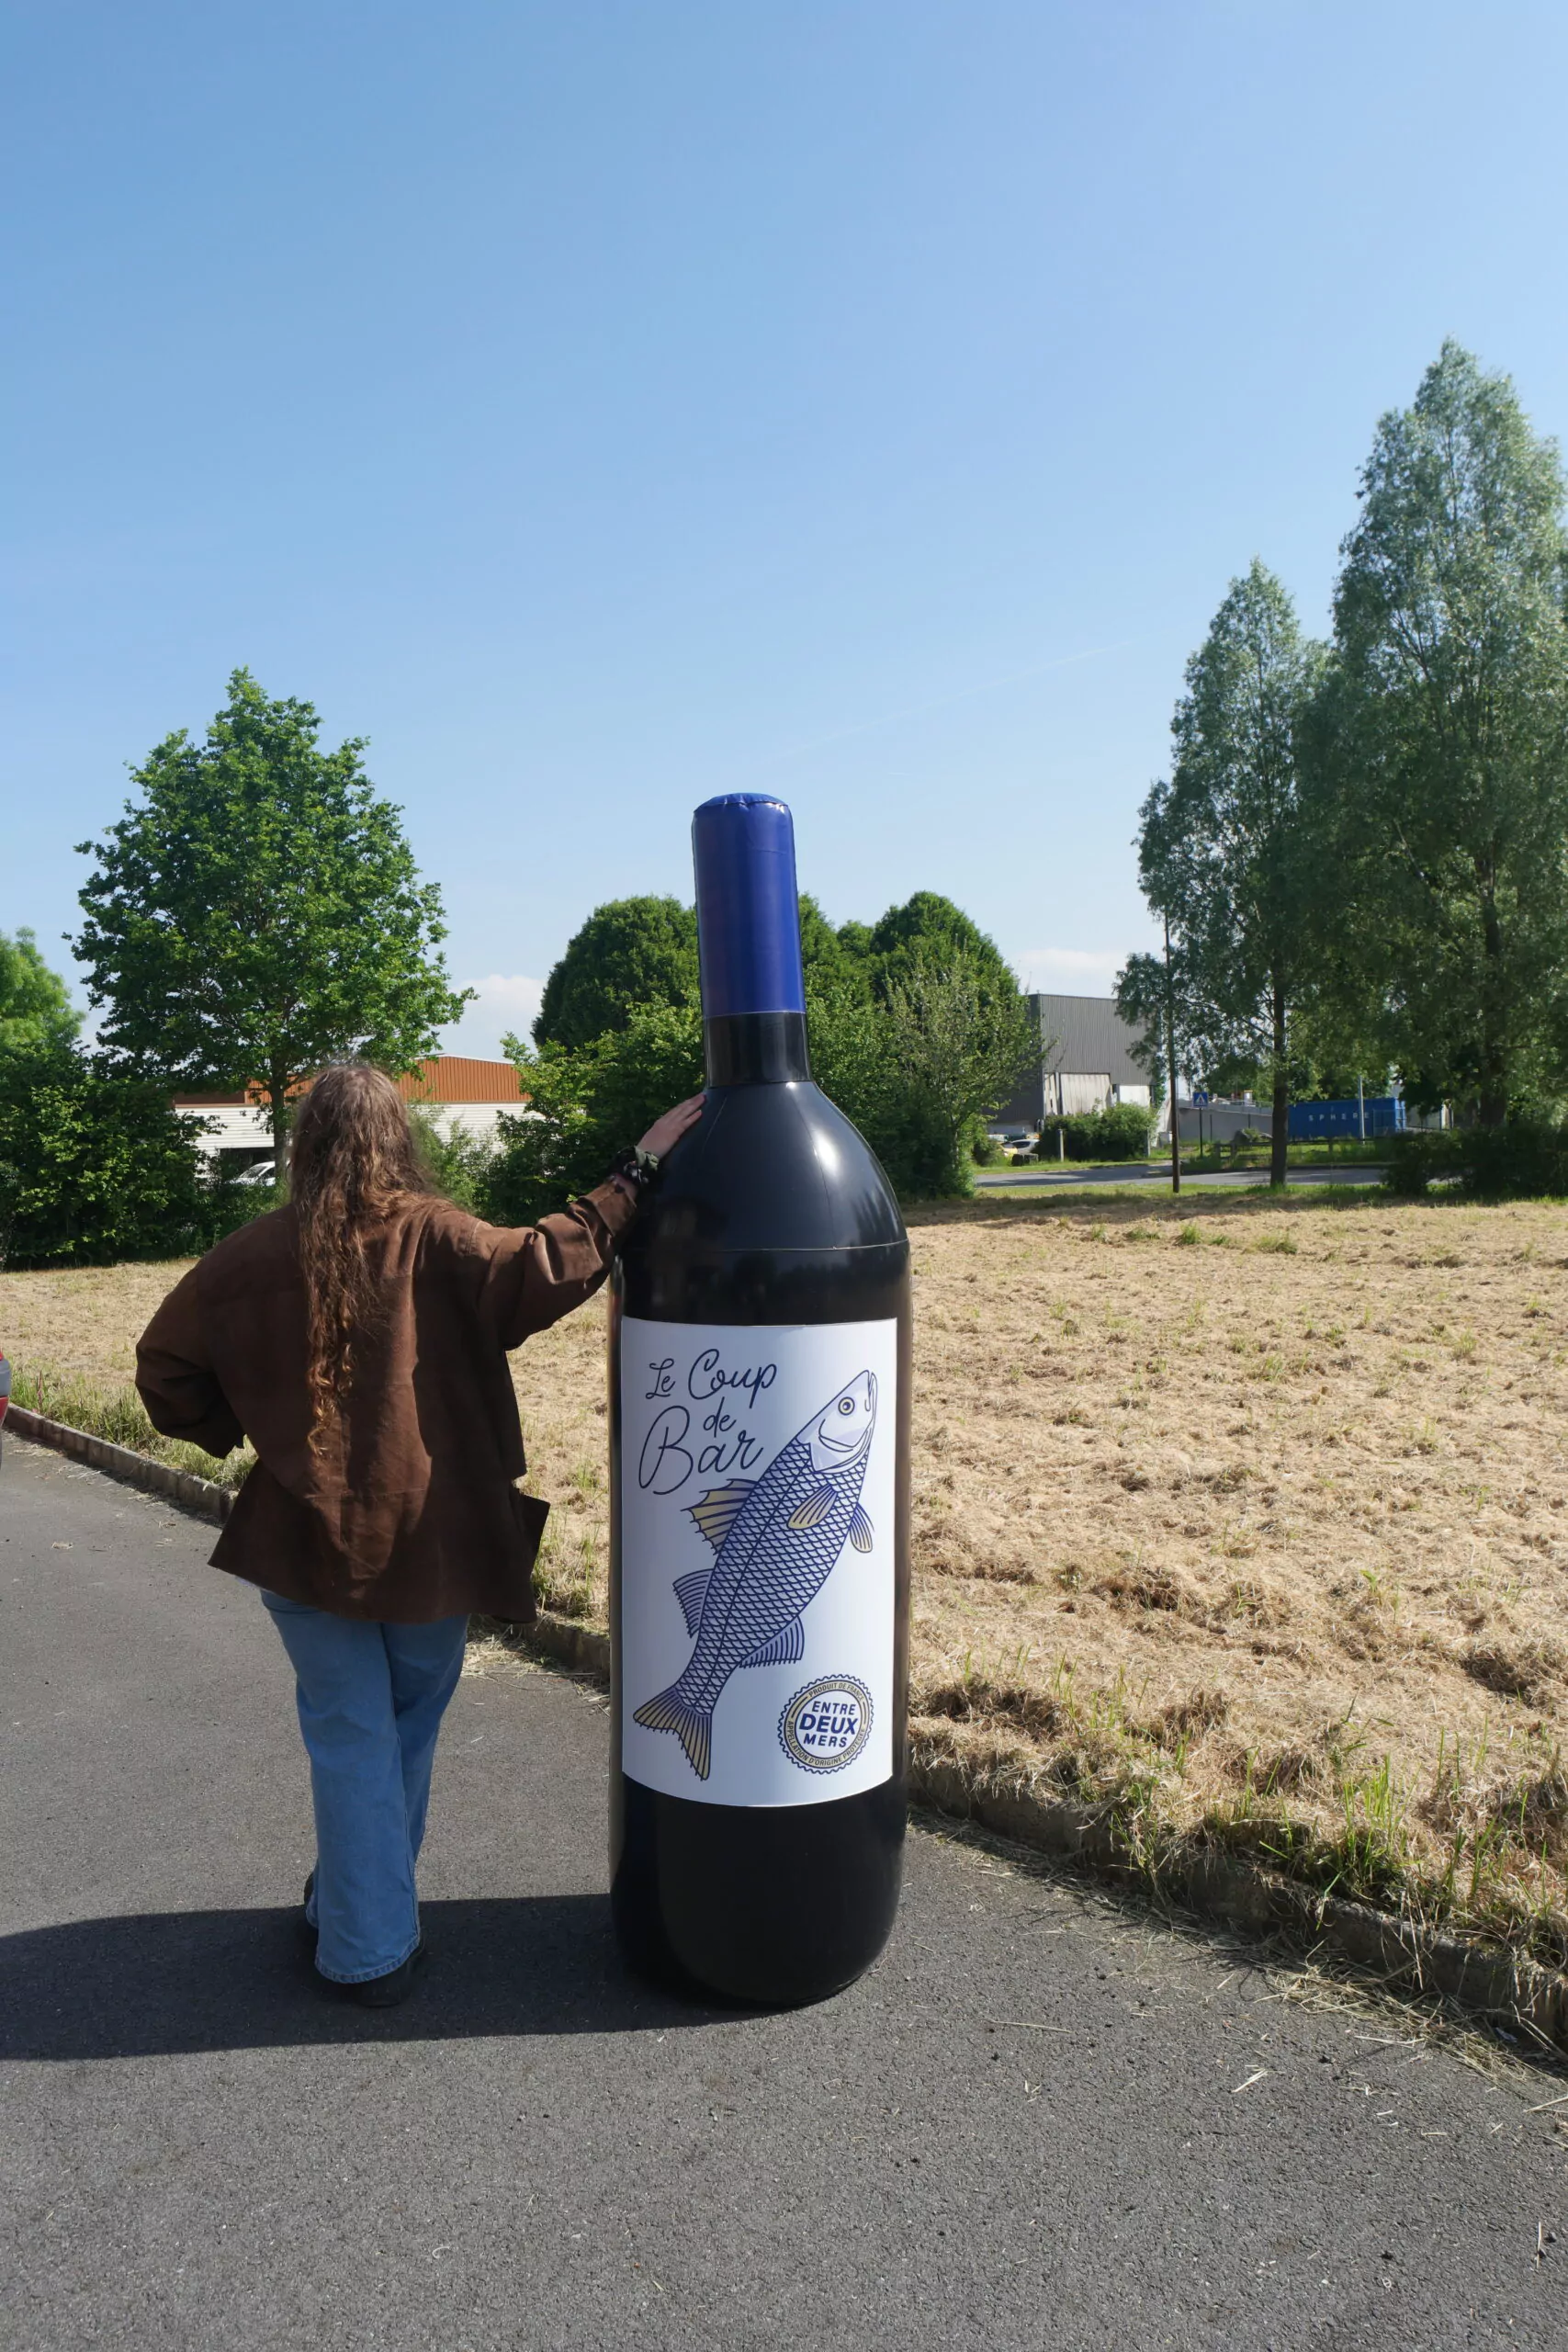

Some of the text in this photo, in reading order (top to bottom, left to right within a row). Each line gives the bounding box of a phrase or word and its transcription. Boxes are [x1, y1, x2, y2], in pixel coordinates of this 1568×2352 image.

[1308, 1112, 1370, 1122] SPHERE
[645, 1349, 777, 1409] Le Coup
[703, 1396, 737, 1438] de
[637, 1405, 763, 1496] Bar
[808, 1682, 838, 1698] PRODUIT
[811, 1701, 856, 1716] ENTRE
[798, 1713, 858, 1736] DEUX
[786, 1720, 809, 1761] APPELLATION
[808, 1757, 842, 1767] D'ORIGINE
[803, 1733, 848, 1748] MERS
